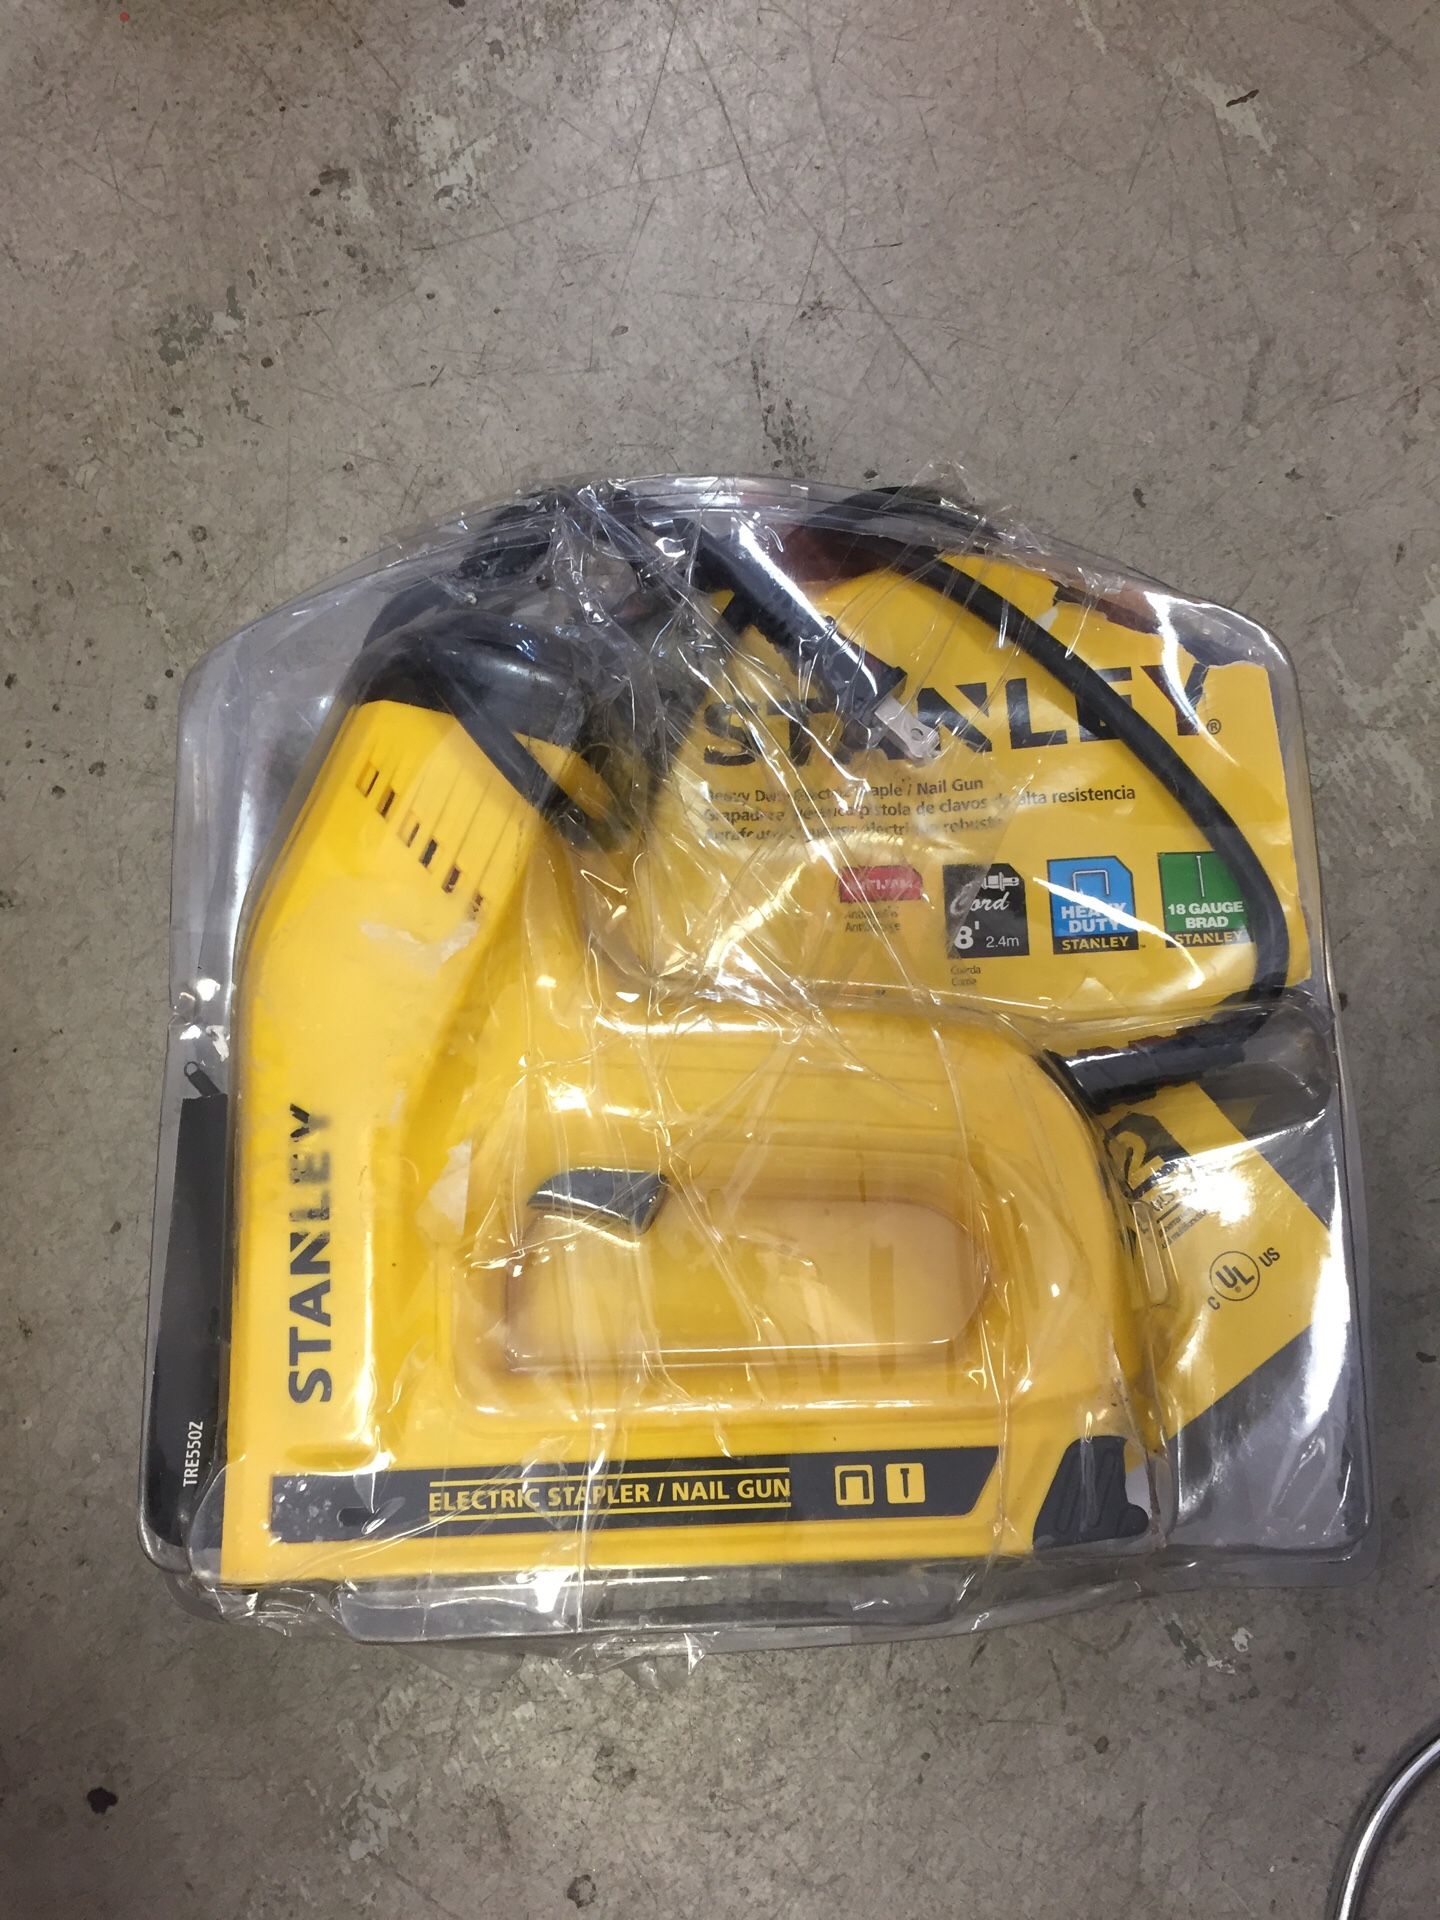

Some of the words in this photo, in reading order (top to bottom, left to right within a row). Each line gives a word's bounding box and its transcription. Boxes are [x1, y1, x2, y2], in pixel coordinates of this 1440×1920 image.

[916, 778, 947, 796] Nail
[952, 779, 983, 791] Gun
[916, 801, 935, 815] de
[939, 798, 988, 813] clavos
[1018, 793, 1047, 806] alta
[1051, 786, 1136, 804] resistencia
[951, 890, 1009, 915] Cord
[1061, 902, 1127, 919] HEA
[1167, 903, 1186, 915] 18
[1189, 901, 1244, 914] GAUGE
[1185, 916, 1229, 929] BRAD
[986, 936, 1020, 948] 2.4m
[1062, 936, 1129, 950] STANLEY
[1174, 930, 1243, 945] STANLEY
[288, 1103, 333, 1403] STANLEY
[1258, 1247, 1281, 1267] US
[1215, 1265, 1255, 1289] UL
[183, 1421, 204, 1487] TRE550Z
[429, 1487, 541, 1511] ELECTRIC
[548, 1483, 651, 1507] STAPLER
[655, 1483, 665, 1503] /
[672, 1480, 729, 1501] NAIL
[738, 1478, 791, 1499] GUN
